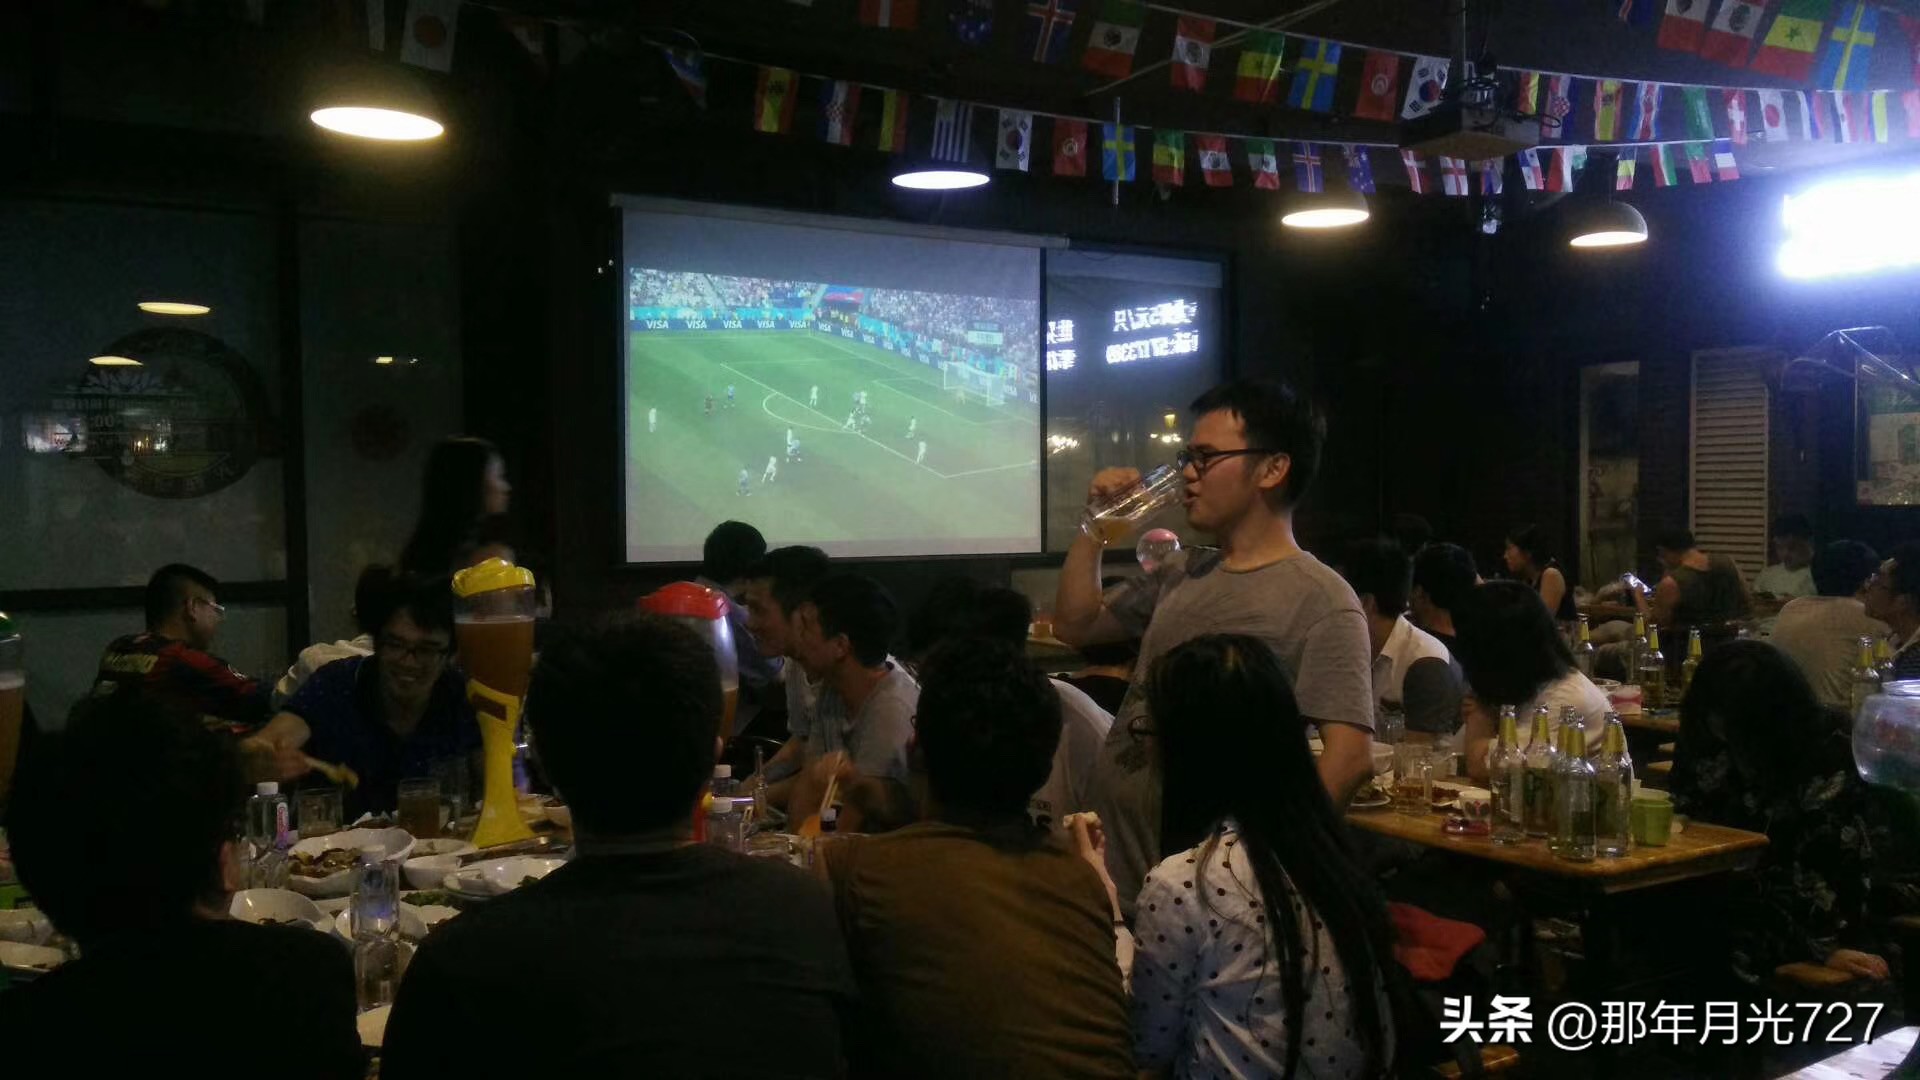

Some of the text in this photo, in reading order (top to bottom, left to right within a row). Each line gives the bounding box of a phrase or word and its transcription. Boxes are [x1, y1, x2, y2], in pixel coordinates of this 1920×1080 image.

[647, 320, 807, 329] VISA VISA VISA VISA VISA
[818, 322, 832, 332] VISA
